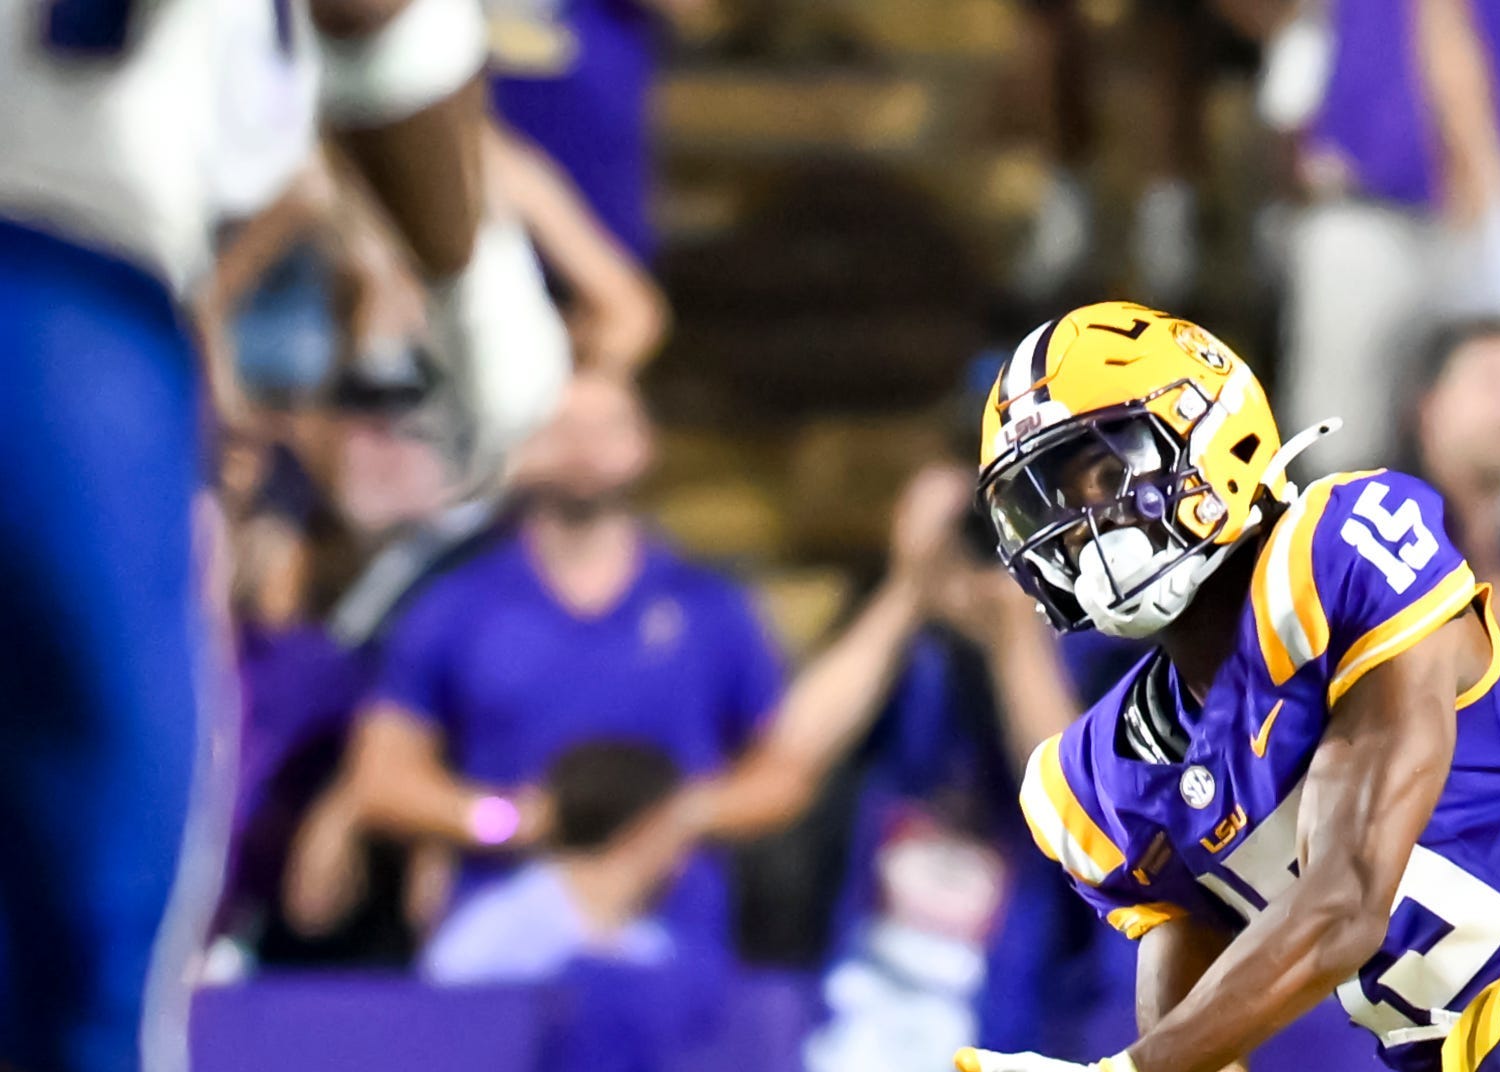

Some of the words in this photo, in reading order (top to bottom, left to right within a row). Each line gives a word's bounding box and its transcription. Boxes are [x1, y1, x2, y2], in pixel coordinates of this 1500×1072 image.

[1004, 411, 1041, 445] LSU
[1340, 482, 1439, 594] 15
[1200, 803, 1248, 854] LSU
